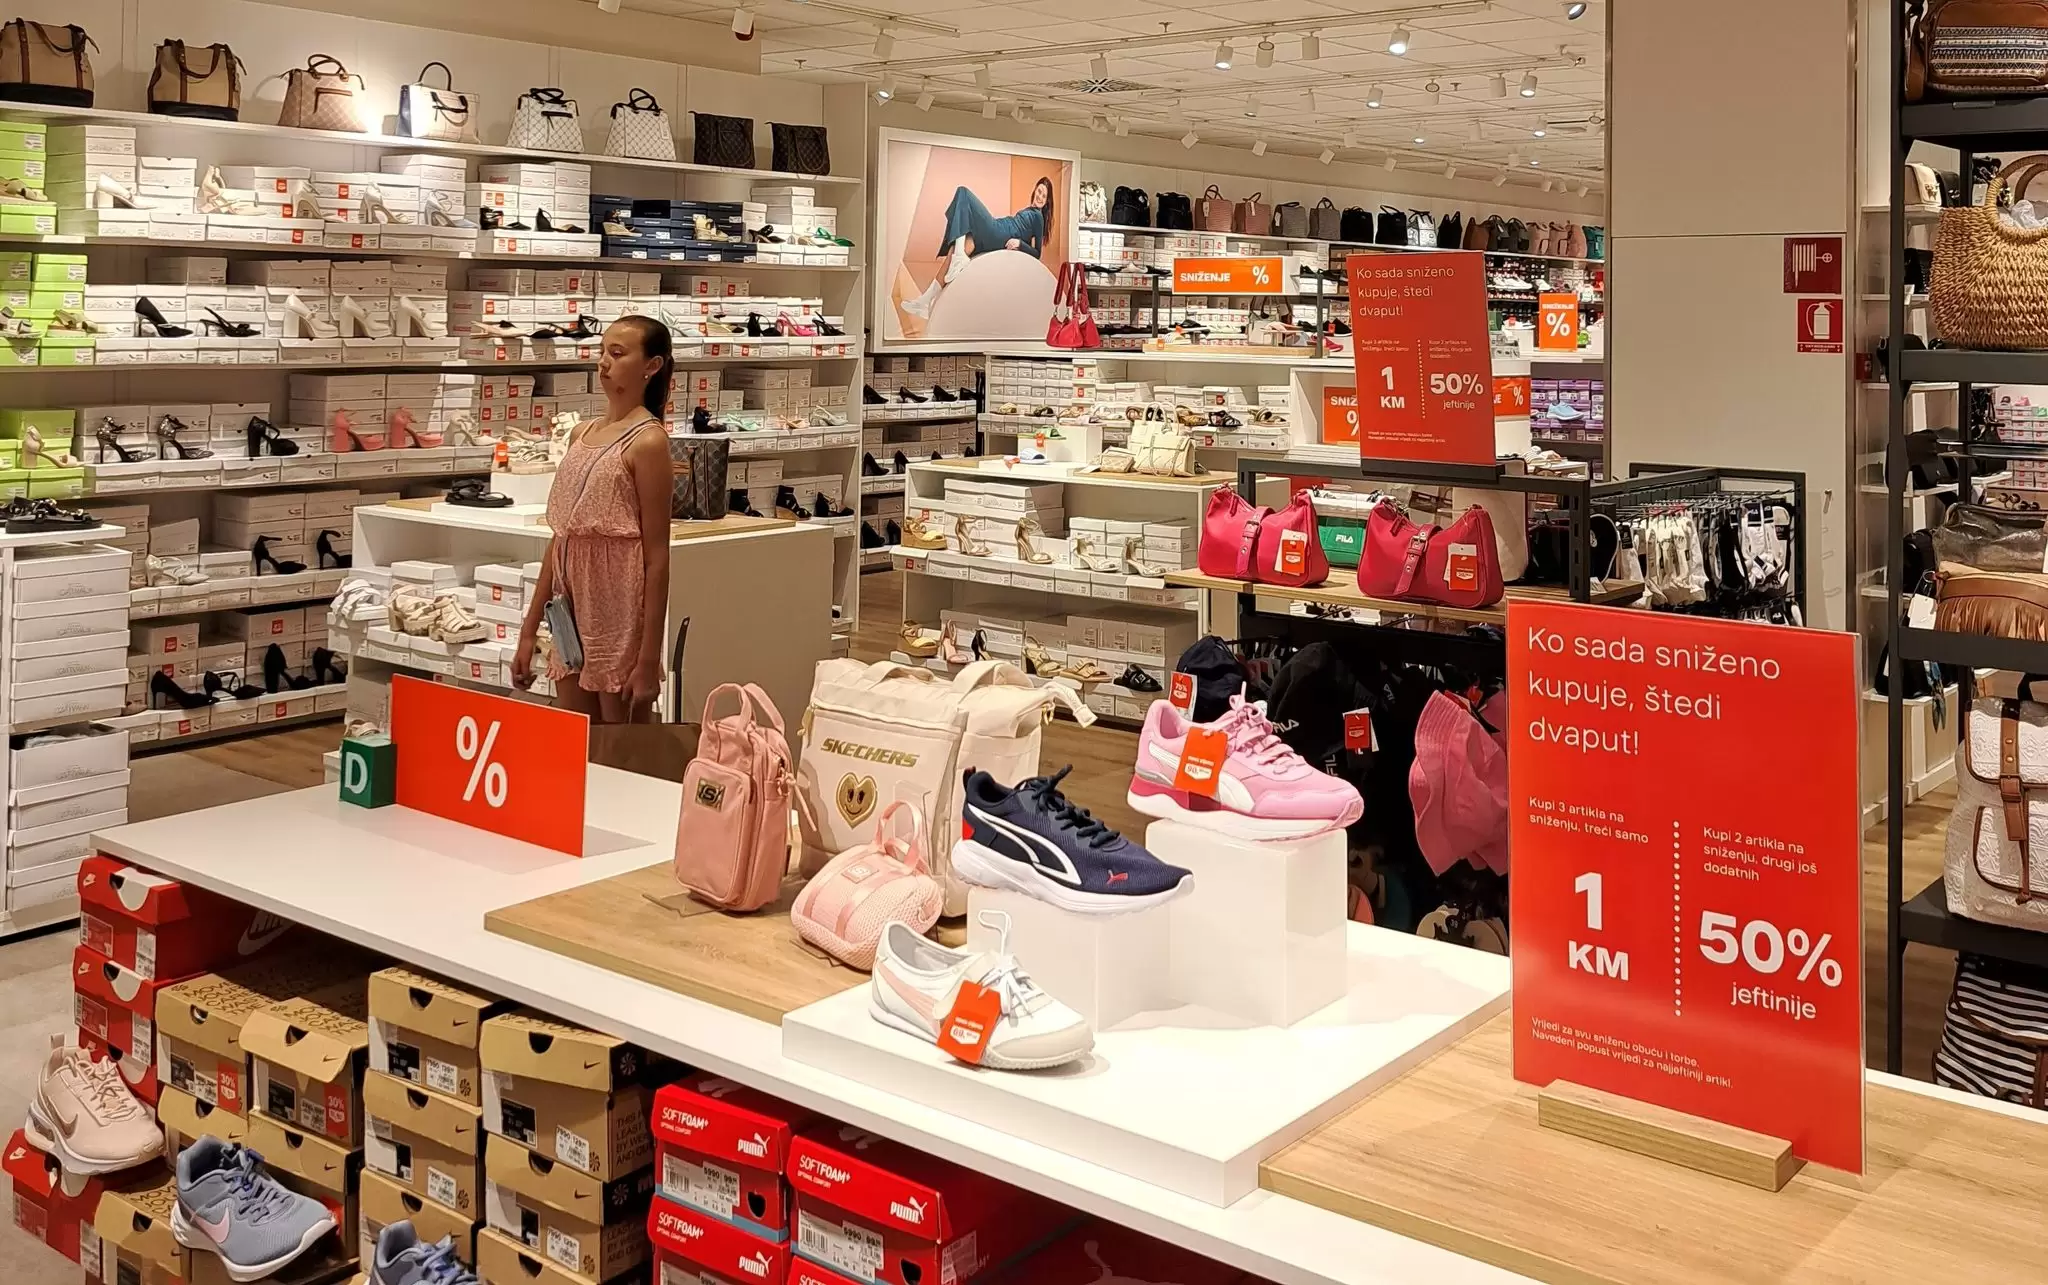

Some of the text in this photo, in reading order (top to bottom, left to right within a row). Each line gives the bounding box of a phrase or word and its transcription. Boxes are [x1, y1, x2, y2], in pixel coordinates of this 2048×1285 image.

[1180, 270, 1231, 282] SNIŽENJE
[1357, 266, 1454, 279] Ko sada sniženo
[1358, 285, 1433, 299] kupuje, štedi
[1359, 305, 1404, 318] dvaput!
[1381, 366, 1394, 390] 1
[1430, 373, 1483, 395] 50%
[1330, 395, 1358, 406] SNIŽ
[1381, 396, 1405, 409] KM
[1443, 400, 1475, 410] jeftinije
[1335, 534, 1354, 544] FILA
[1528, 626, 1780, 680] Ko sada sniženo
[1528, 670, 1721, 720] kupuje, štedi
[1528, 716, 1639, 755] dvaput!
[456, 715, 508, 808] %
[820, 737, 920, 768] SKECHERS
[344, 751, 369, 794] D
[1529, 796, 1624, 823] Kupi 3 artikla na
[1529, 813, 1649, 843] sniženju, treći samo
[1703, 826, 1804, 854] Kupi 2 artikla na
[1703, 845, 1818, 874] sniženju, drugi još
[1703, 861, 1760, 881] dodatnih
[1574, 871, 1603, 931] 1
[1568, 939, 1629, 981] KM
[1699, 909, 1843, 987] 50%
[1730, 981, 1817, 1021] jeftinije
[1531, 1016, 1560, 1033] Vrijedi
[1562, 1025, 1572, 1036] za
[1575, 1029, 1591, 1040] svu
[1593, 1033, 1630, 1050] sniženu
[1632, 1042, 1663, 1058] obuću
[1532, 1028, 1575, 1048] Navedeni
[1577, 1041, 1610, 1057] popust
[1612, 1049, 1641, 1065] vrijedi
[1643, 1058, 1654, 1068] za
[1656, 1061, 1703, 1081] najjeftiniji
[738, 1138, 765, 1157] PUMA
[890, 1201, 922, 1224] PUMA
[738, 1255, 765, 1278] PUMA
